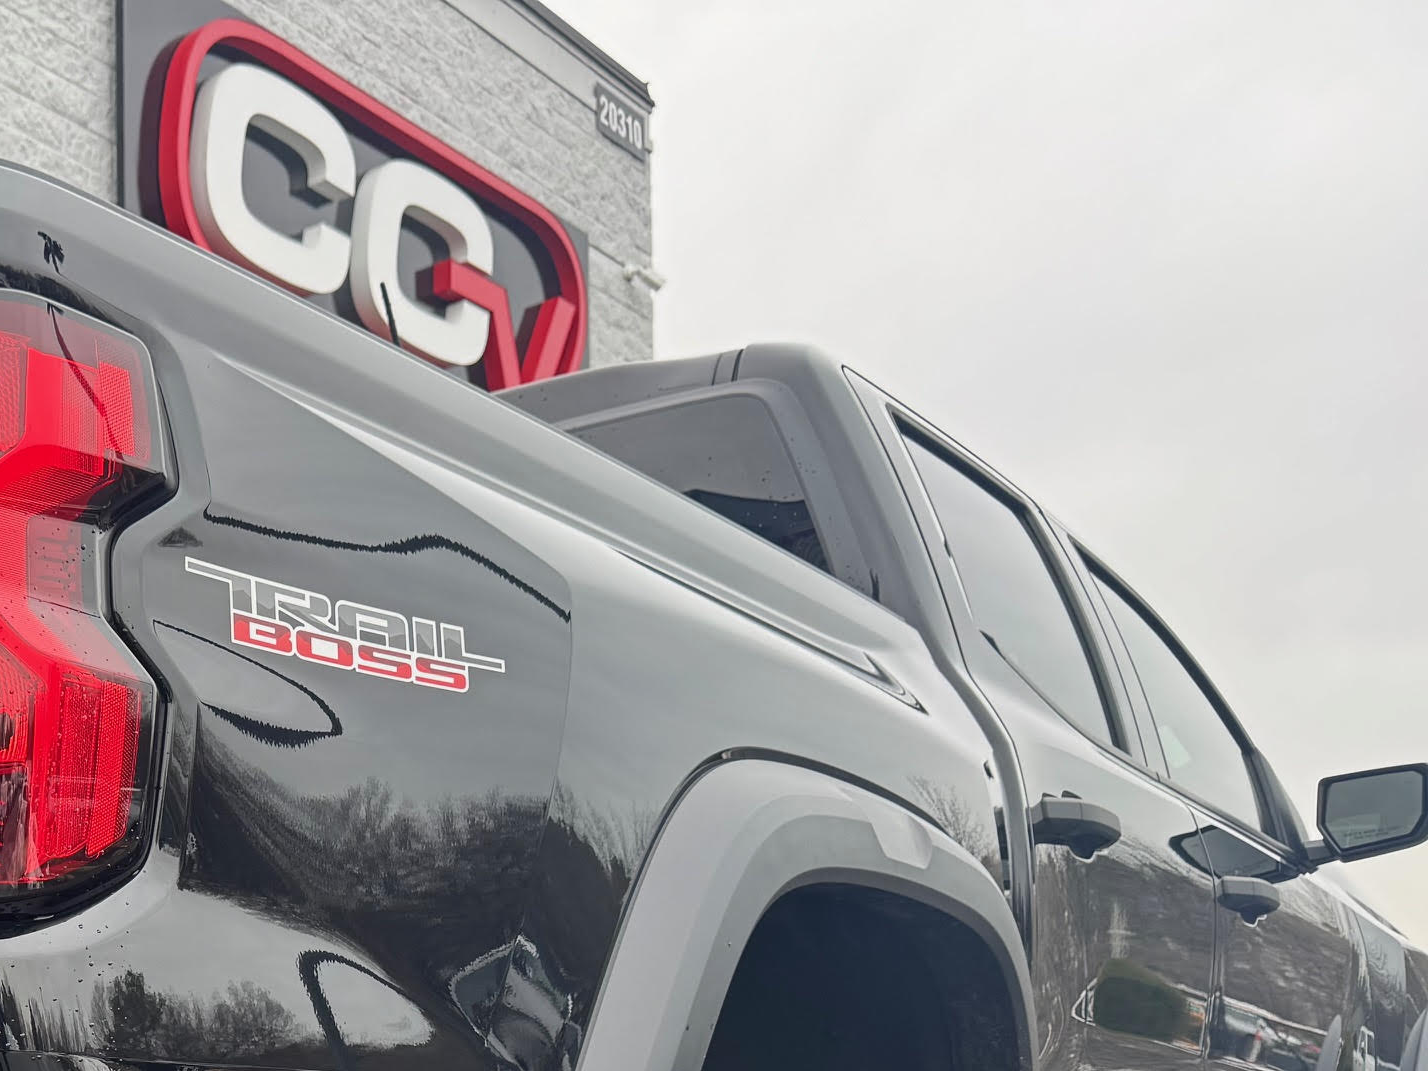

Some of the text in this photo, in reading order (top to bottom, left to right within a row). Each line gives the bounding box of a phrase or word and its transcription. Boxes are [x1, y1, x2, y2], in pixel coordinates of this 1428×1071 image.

[599, 94, 643, 150] 20310
[184, 555, 506, 673] TRAIL
[229, 609, 470, 693] BOSS
